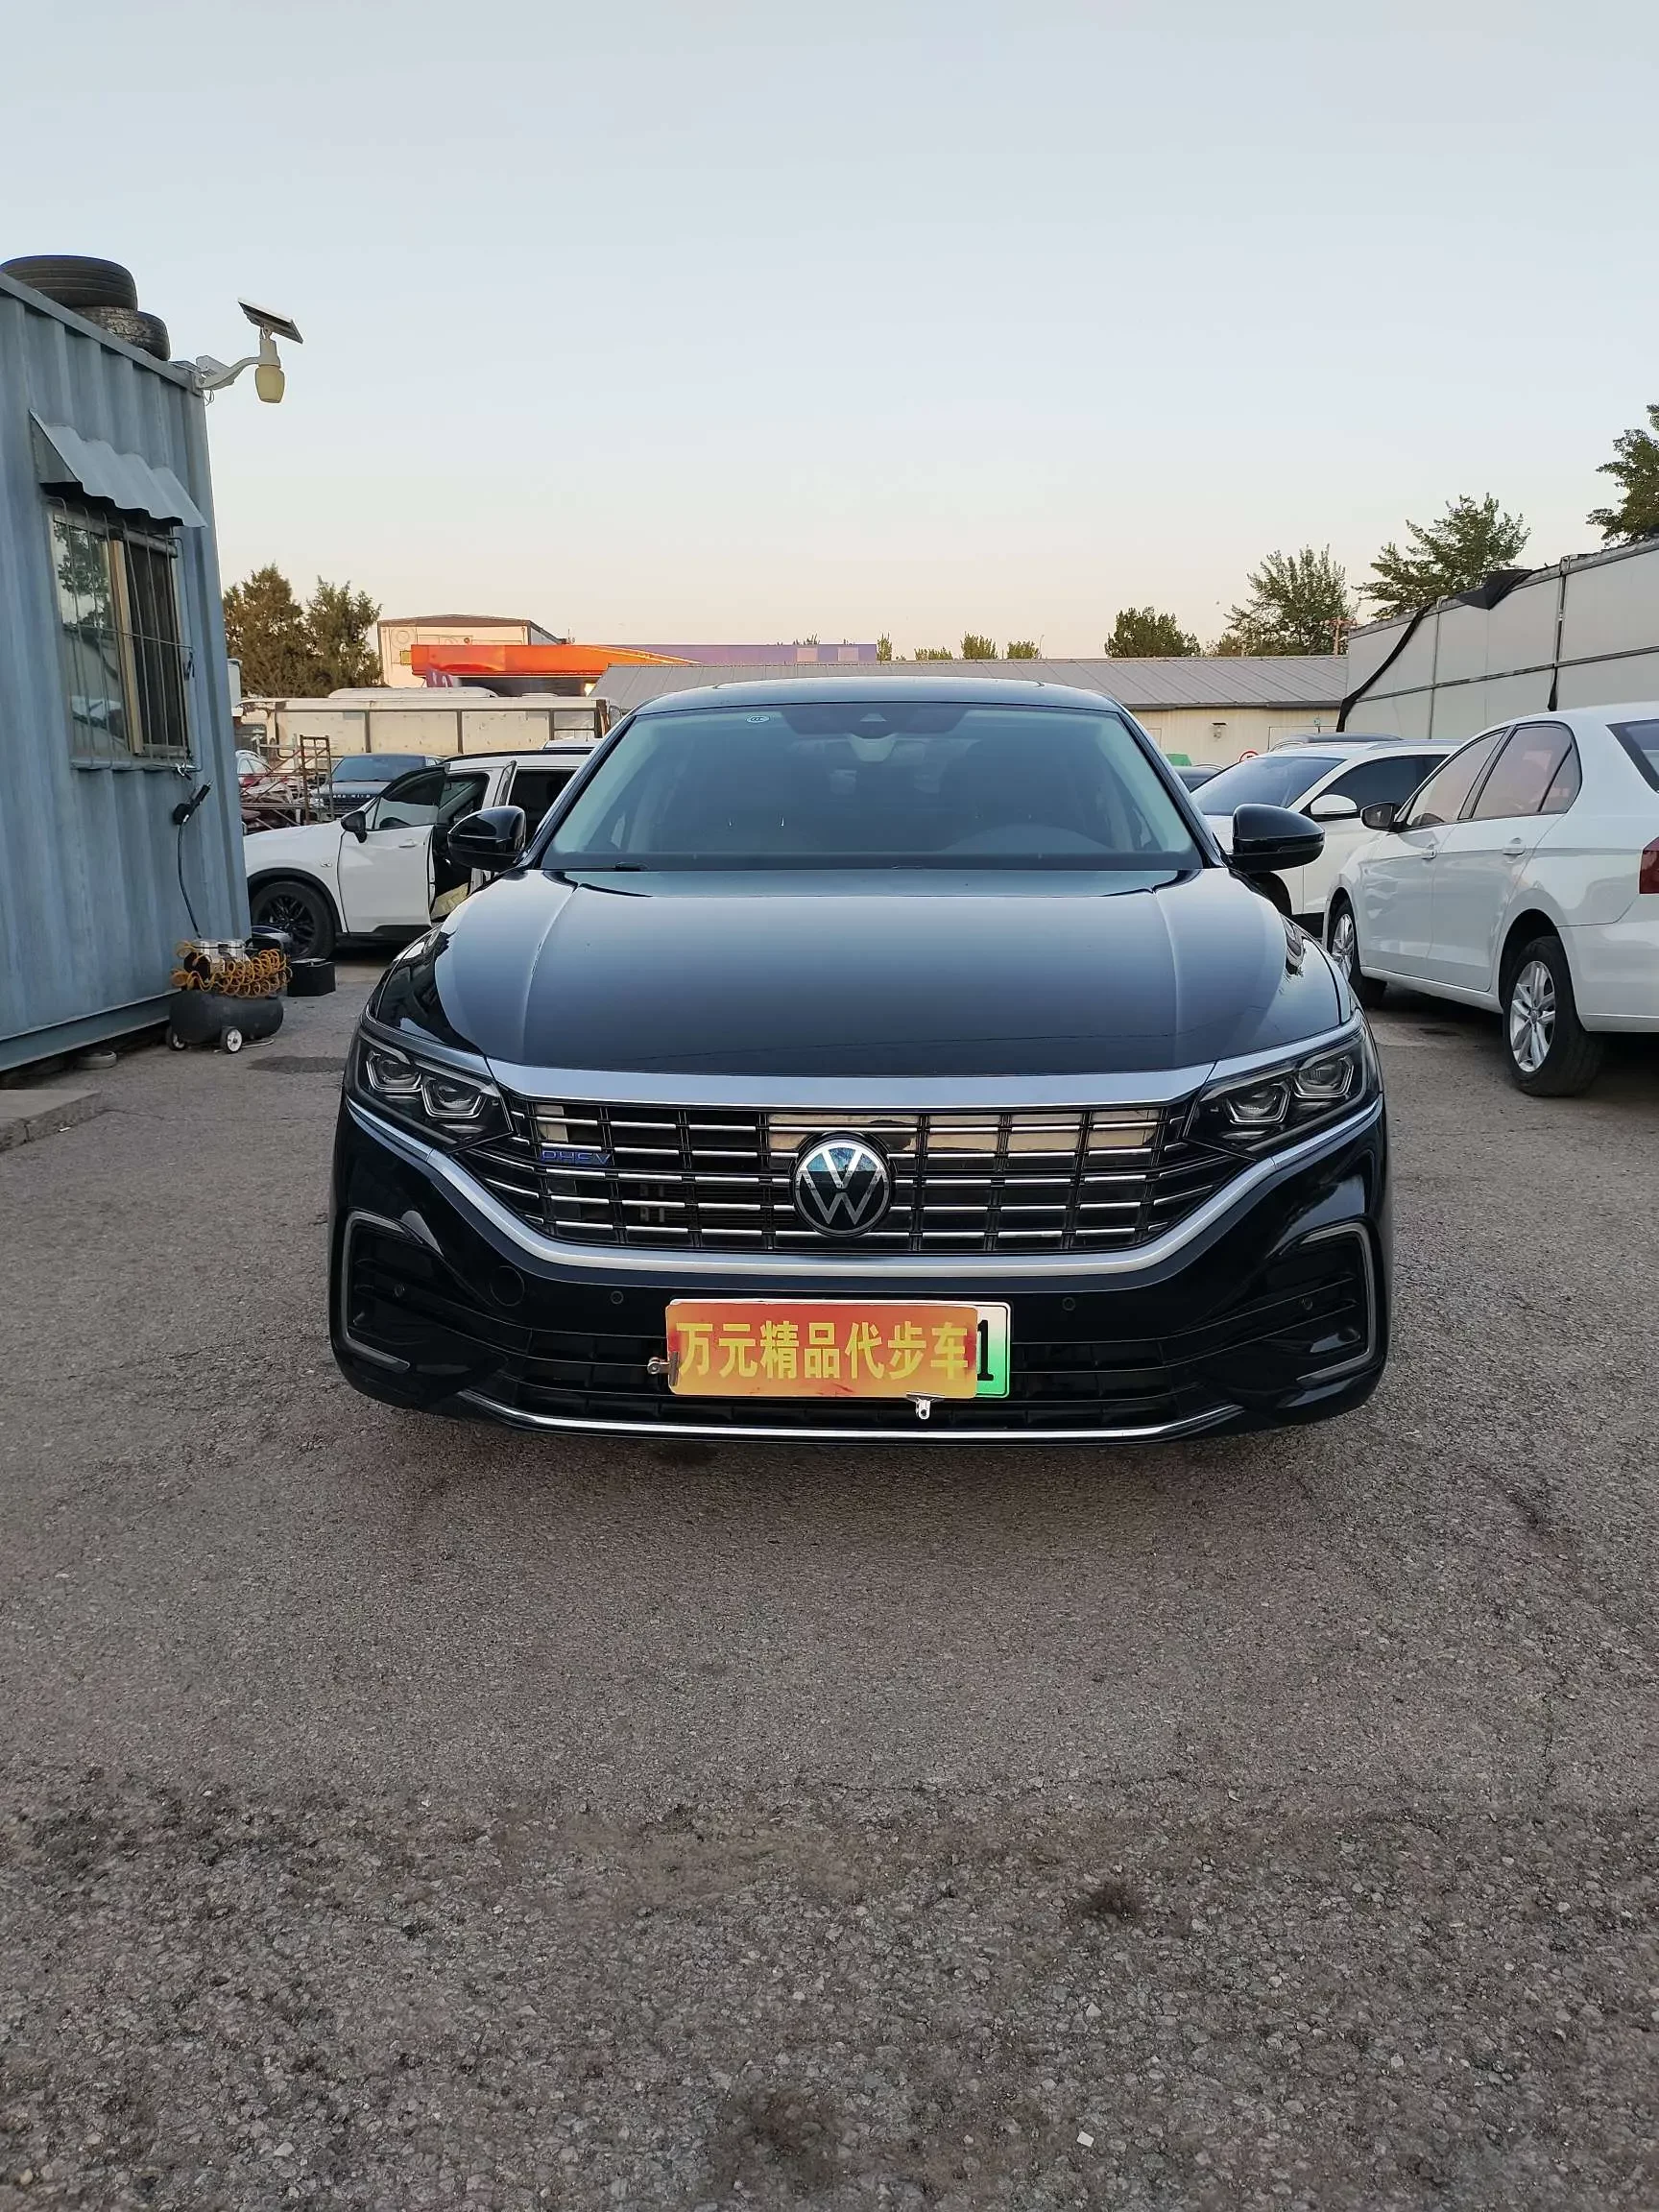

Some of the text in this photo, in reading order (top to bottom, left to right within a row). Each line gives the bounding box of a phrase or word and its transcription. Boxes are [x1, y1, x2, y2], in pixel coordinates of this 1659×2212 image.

[676, 1320, 969, 1381] 万元精品代步车
